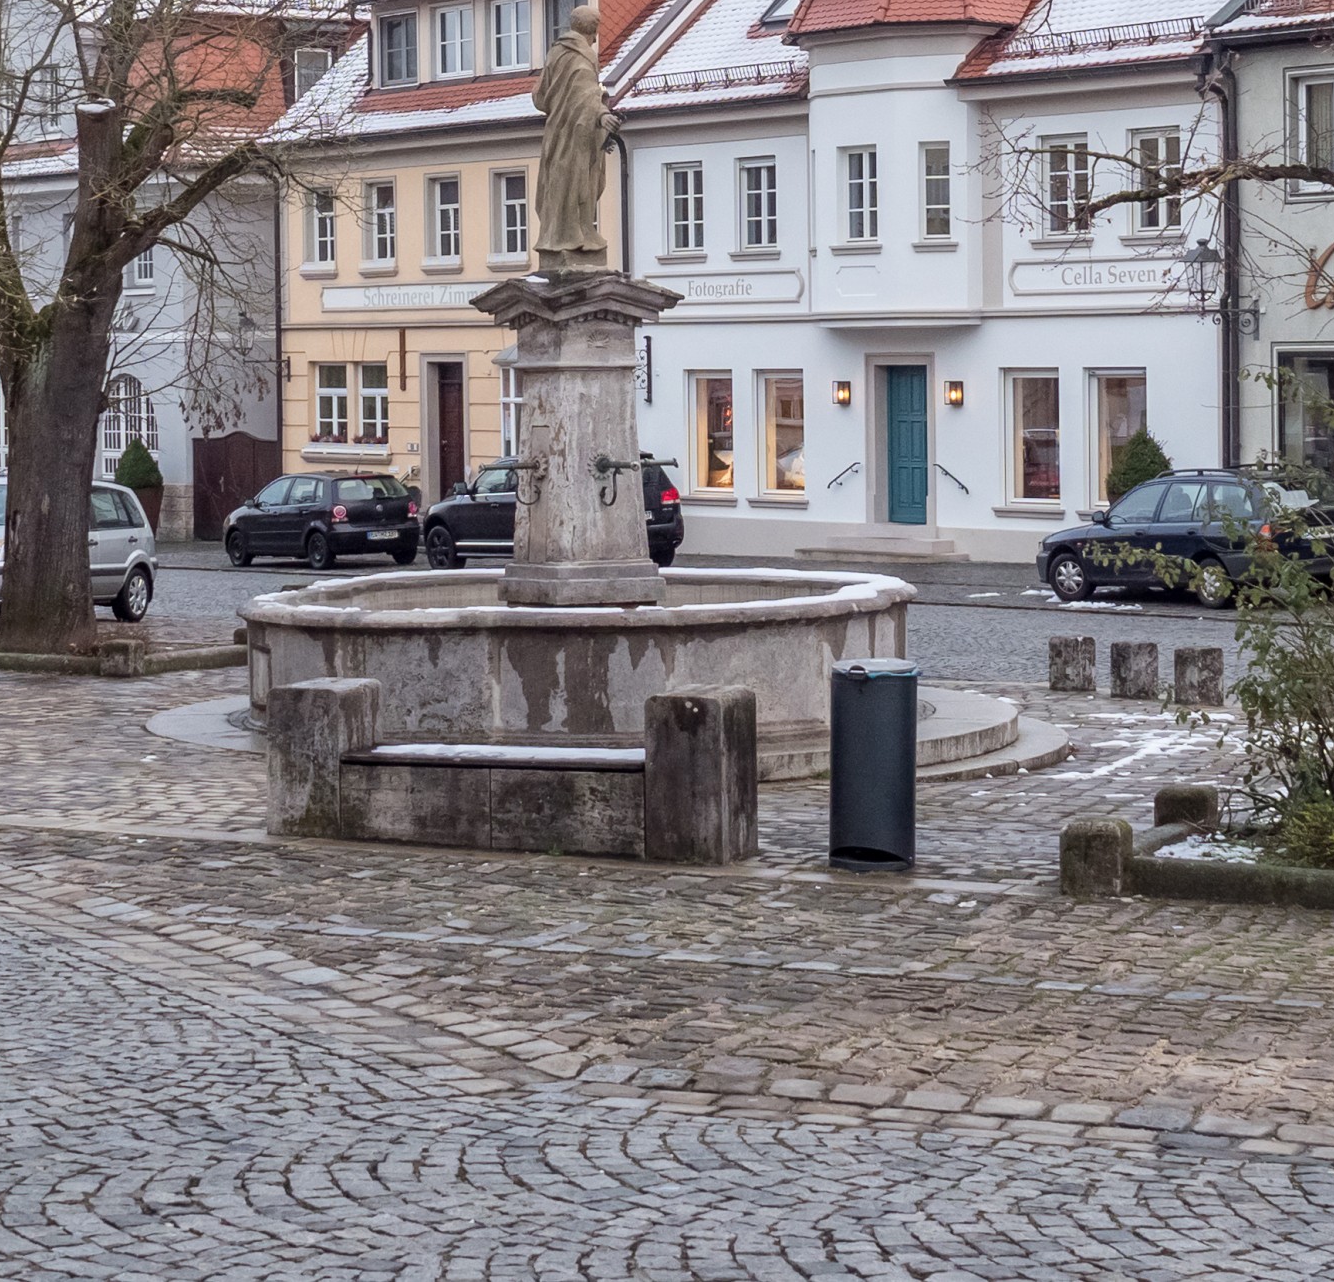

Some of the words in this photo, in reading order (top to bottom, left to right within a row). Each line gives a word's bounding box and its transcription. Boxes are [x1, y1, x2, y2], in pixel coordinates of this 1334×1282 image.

[1061, 266, 1102, 286] Cella
[1107, 264, 1157, 284] Seven
[363, 285, 434, 307] Schreinerei
[687, 278, 753, 299] Fotografie
